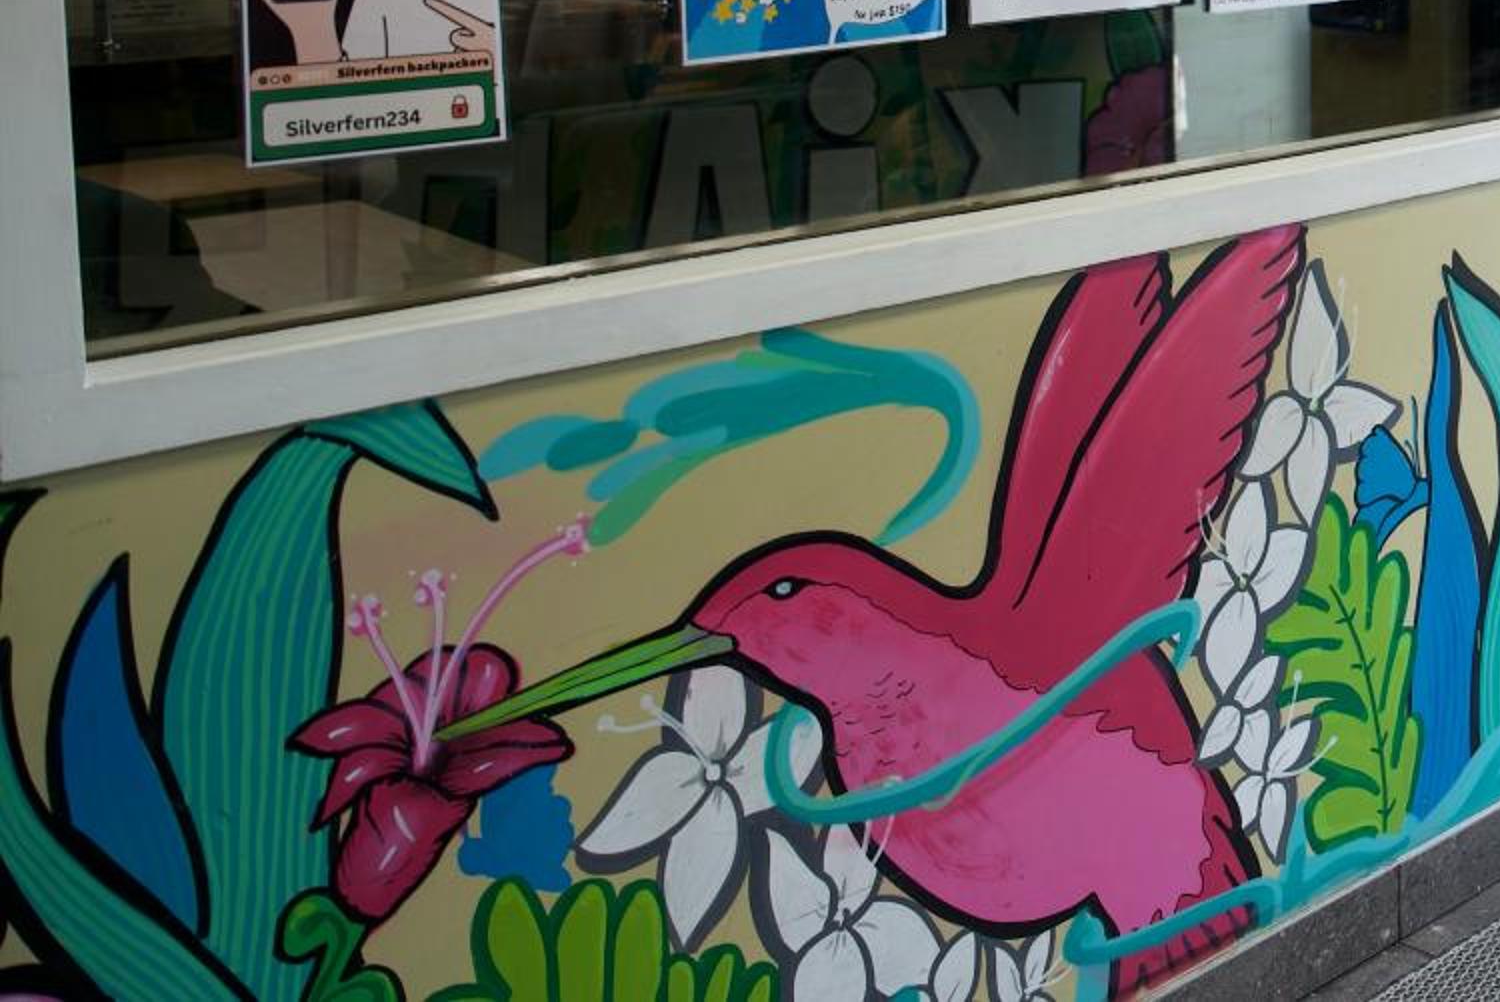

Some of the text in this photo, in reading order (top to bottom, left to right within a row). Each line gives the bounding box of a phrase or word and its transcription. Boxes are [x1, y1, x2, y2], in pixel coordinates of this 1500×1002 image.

[337, 56, 489, 79] Silverfern backpackers
[285, 109, 421, 138] Silverfern234
